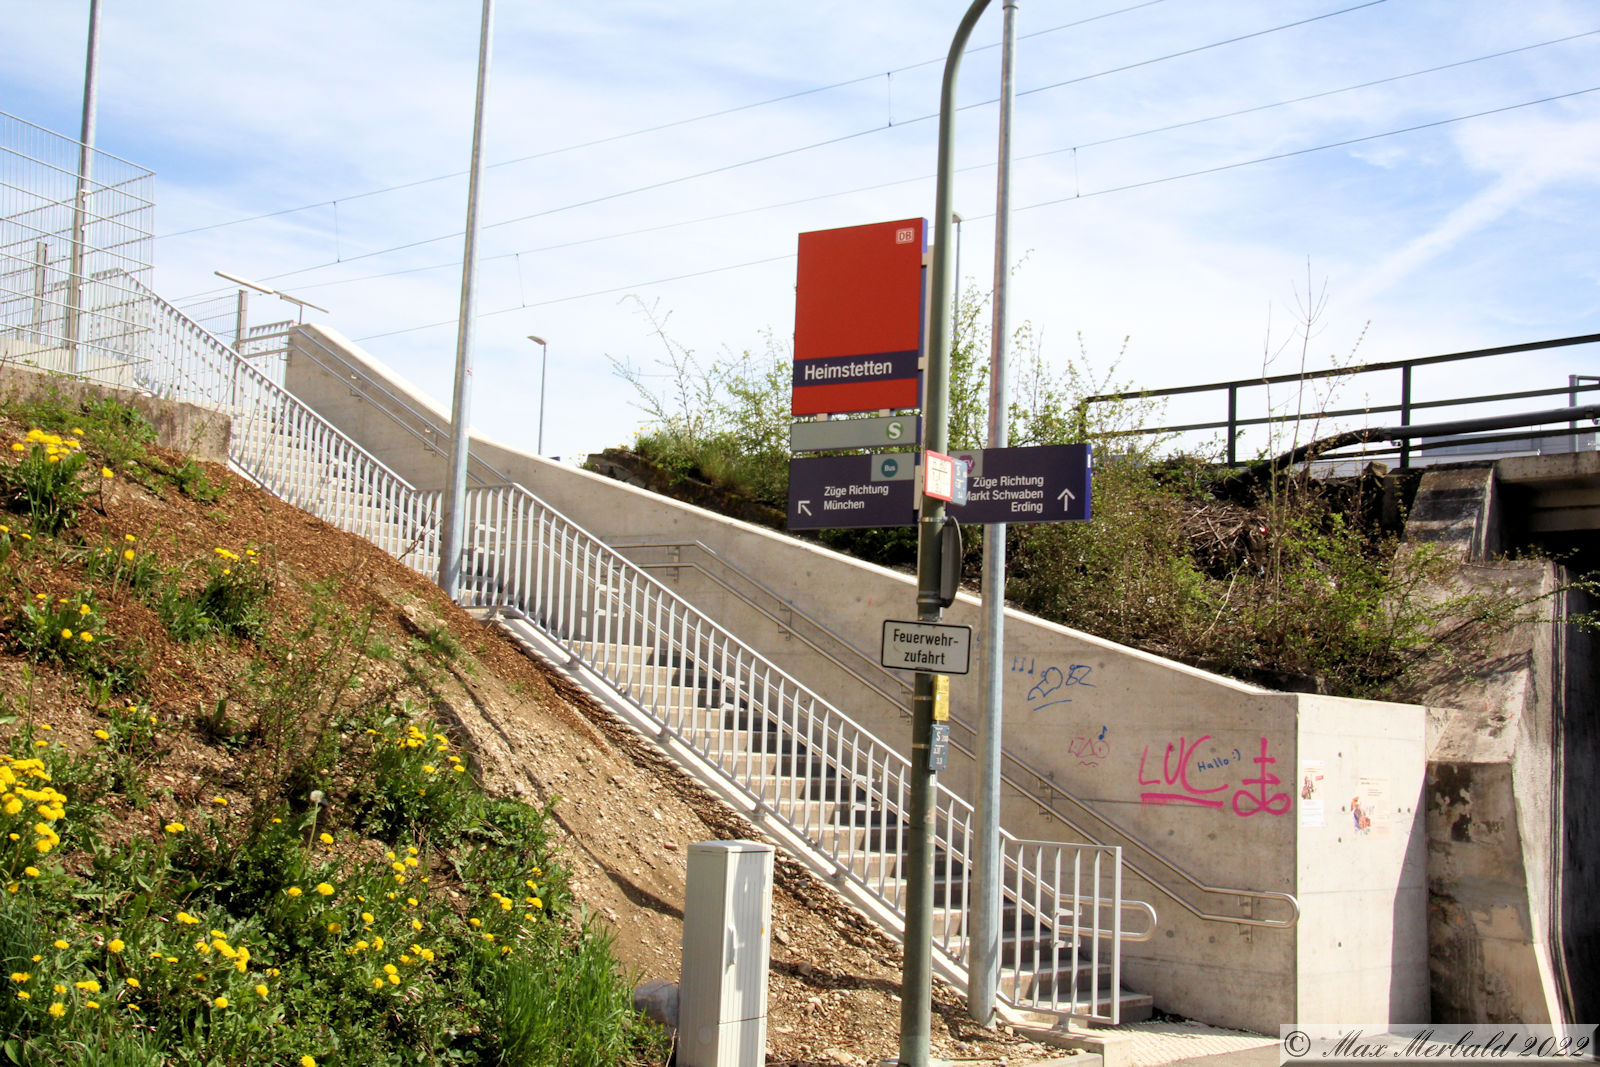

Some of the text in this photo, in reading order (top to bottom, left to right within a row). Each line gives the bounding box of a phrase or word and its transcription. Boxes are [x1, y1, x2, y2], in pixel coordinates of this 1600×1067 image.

[804, 361, 893, 380] Heimstetten
[888, 422, 902, 439] S
[884, 464, 896, 472] Bus
[973, 477, 998, 489] Züge
[1000, 475, 1044, 487] Richtung
[824, 484, 889, 498] Züge Richtung
[992, 489, 1044, 500] Schwaben
[823, 500, 865, 510] München
[1011, 501, 1043, 513] Erding
[893, 629, 959, 647] Feuerwehr-
[904, 651, 946, 665] zufahrt
[1197, 757, 1230, 772] Hallo
